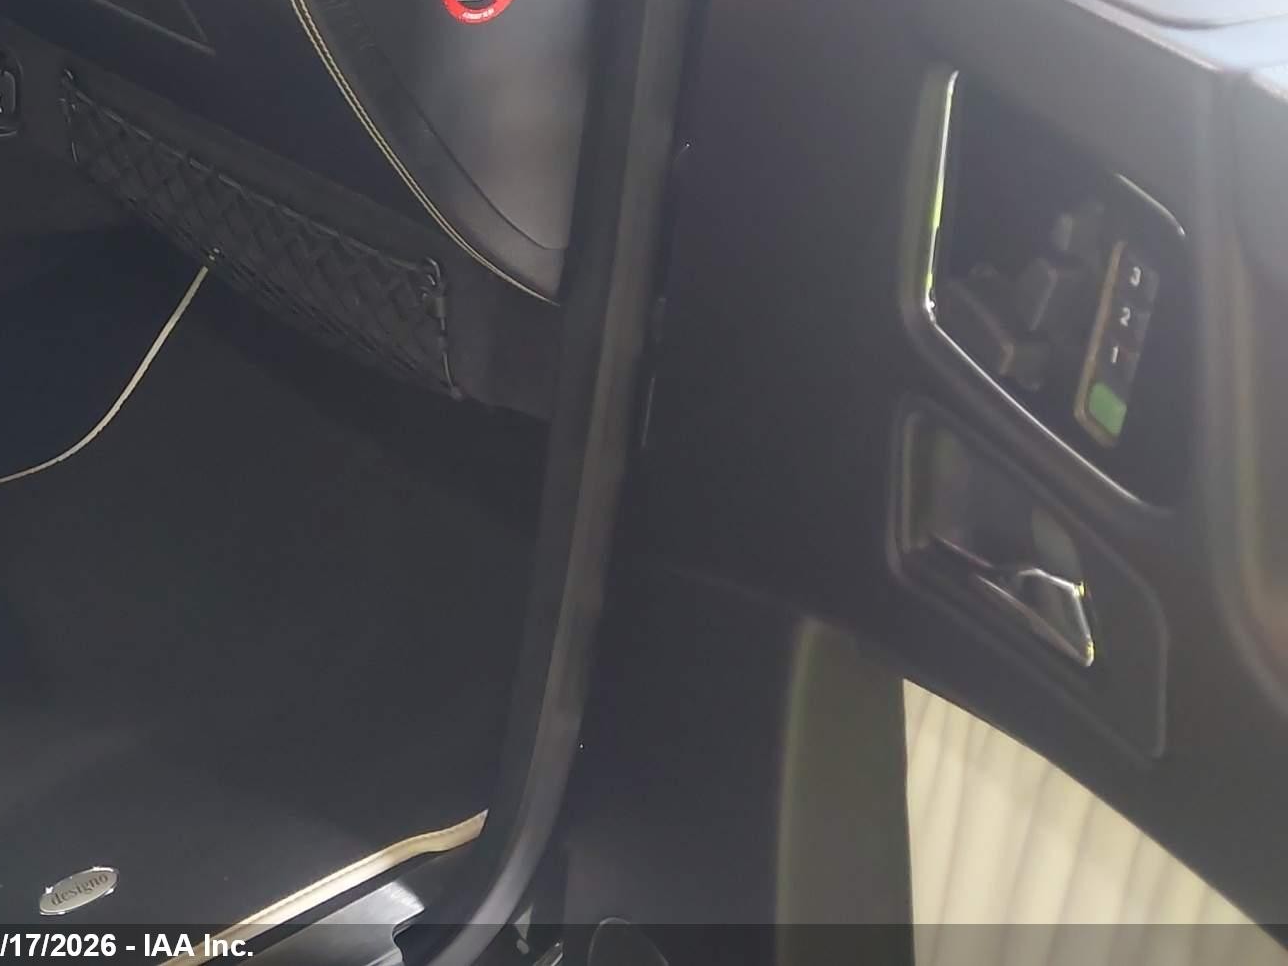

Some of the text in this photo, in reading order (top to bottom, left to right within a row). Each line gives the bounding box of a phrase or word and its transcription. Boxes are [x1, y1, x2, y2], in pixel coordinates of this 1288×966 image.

[1128, 266, 1142, 287] 3
[1119, 306, 1132, 327] 2
[1110, 345, 1120, 364] 1
[50, 873, 109, 907] designo
